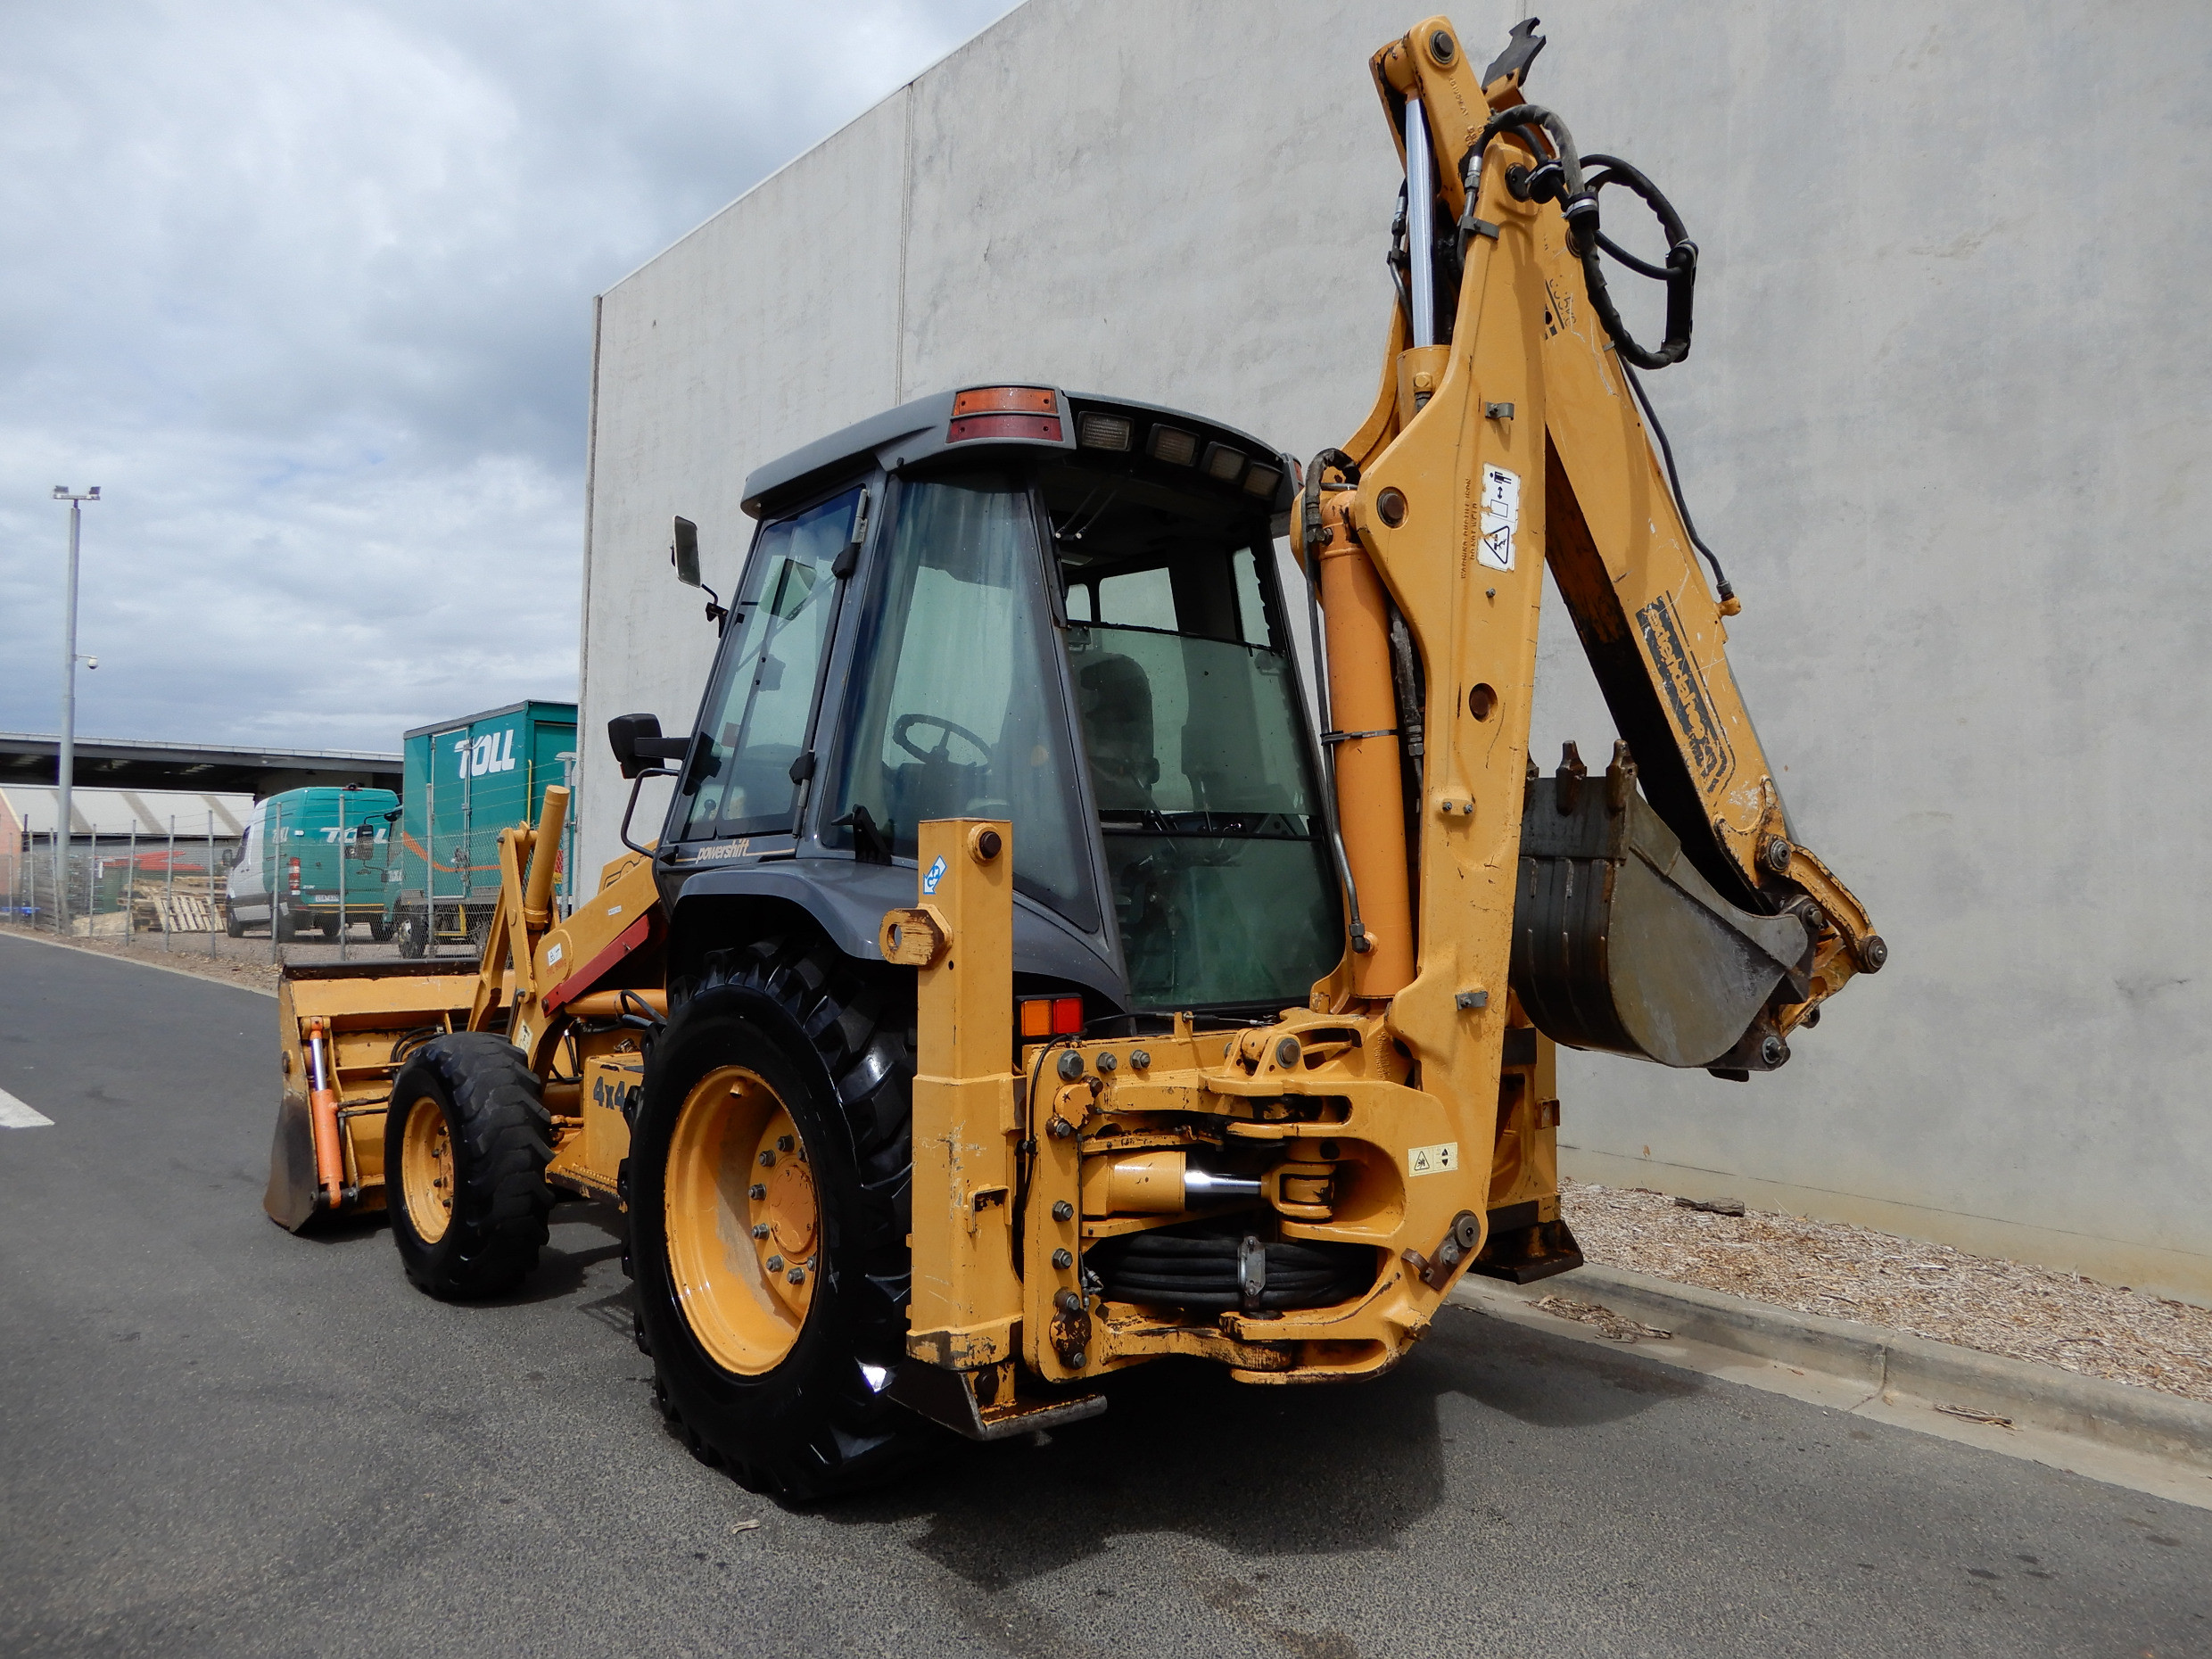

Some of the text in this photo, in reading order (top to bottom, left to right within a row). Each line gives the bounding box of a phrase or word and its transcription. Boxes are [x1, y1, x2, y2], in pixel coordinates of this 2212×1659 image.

[453, 729, 516, 780] TOLL
[319, 826, 388, 844] TOL
[696, 838, 749, 864] powershift
[593, 1076, 626, 1113] 4x4
